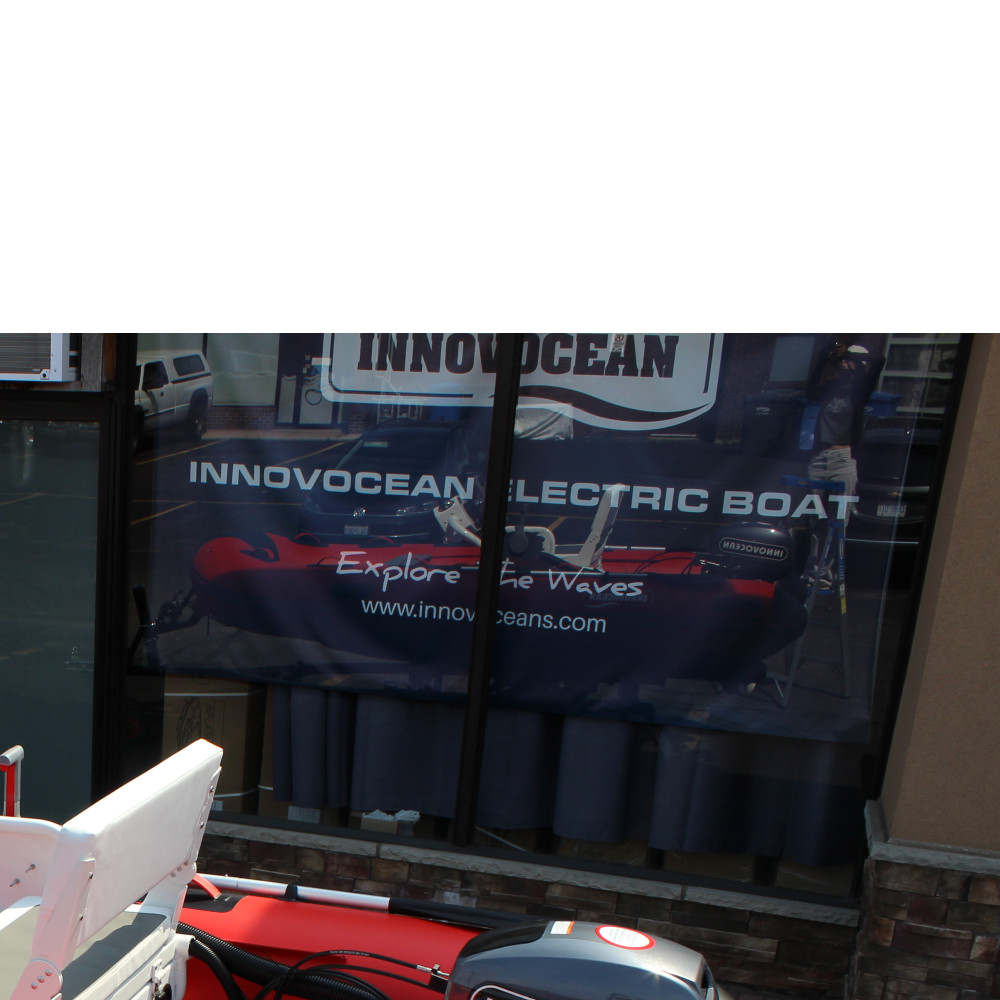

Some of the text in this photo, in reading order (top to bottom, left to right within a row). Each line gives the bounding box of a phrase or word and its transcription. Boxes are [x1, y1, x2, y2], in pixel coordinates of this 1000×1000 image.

[189, 460, 860, 520] INNOVOCEAN LECTRIC BOAT
[336, 551, 644, 597] Explore he Waves
[361, 599, 607, 633] www.innovceans.com
